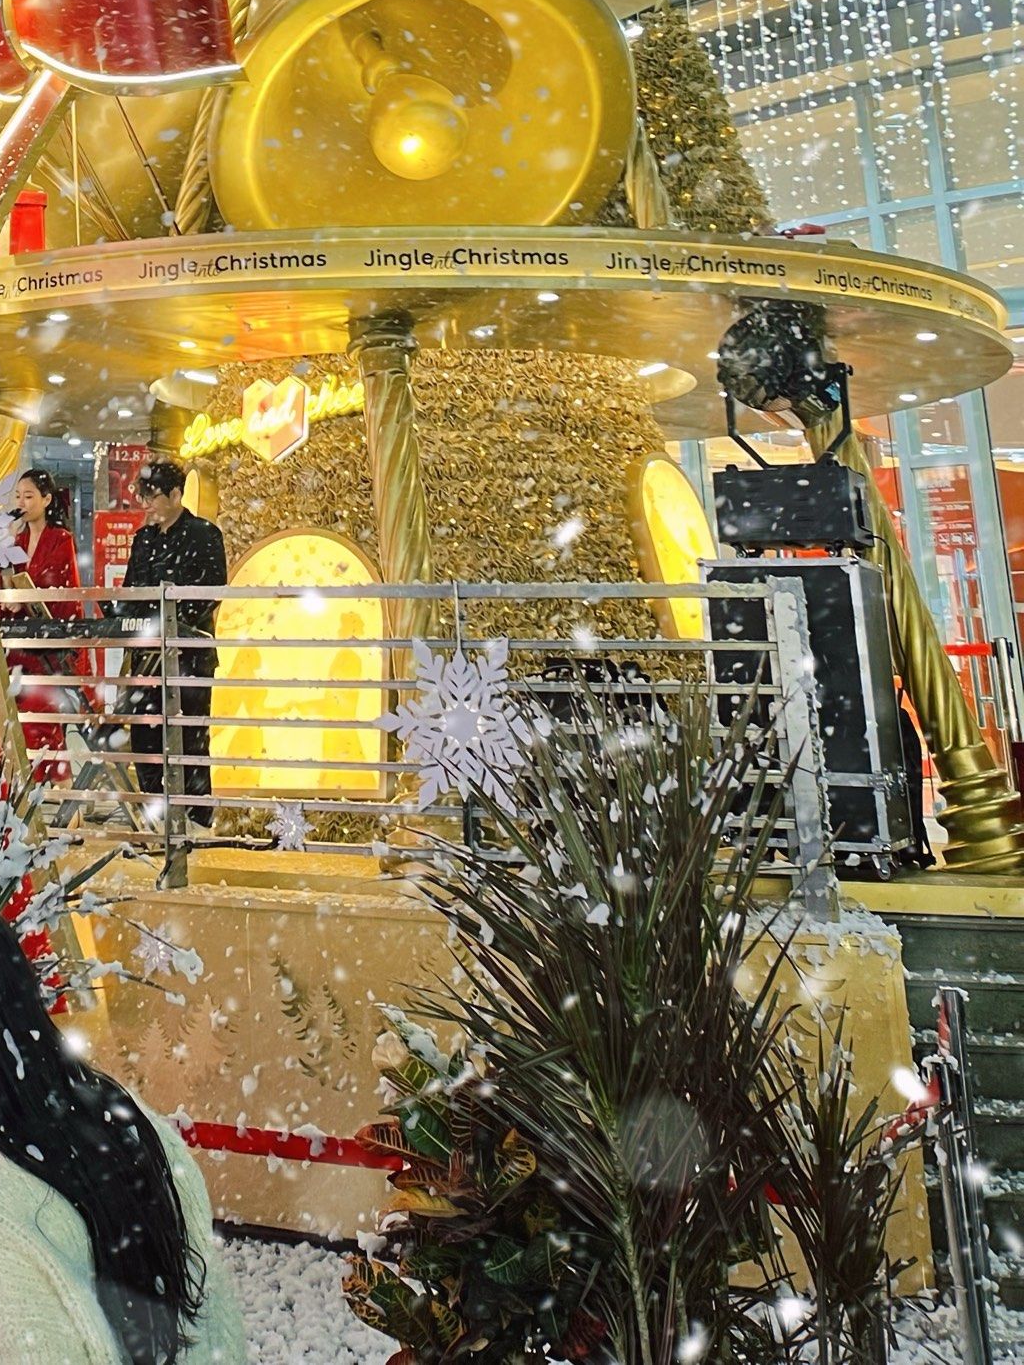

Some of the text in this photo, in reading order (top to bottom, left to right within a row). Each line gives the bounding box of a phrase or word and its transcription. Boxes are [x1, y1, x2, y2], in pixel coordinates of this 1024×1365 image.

[138, 258, 197, 283] Jingle
[215, 251, 327, 272] Christmas
[364, 249, 433, 271] Jingle
[453, 247, 569, 266] Christmas
[605, 252, 670, 275] Jingle
[687, 255, 787, 277] Christmas
[17, 269, 103, 293] Christmas
[814, 269, 861, 292] Jingle
[872, 276, 933, 301] Christmas
[121, 617, 151, 632] KORG
